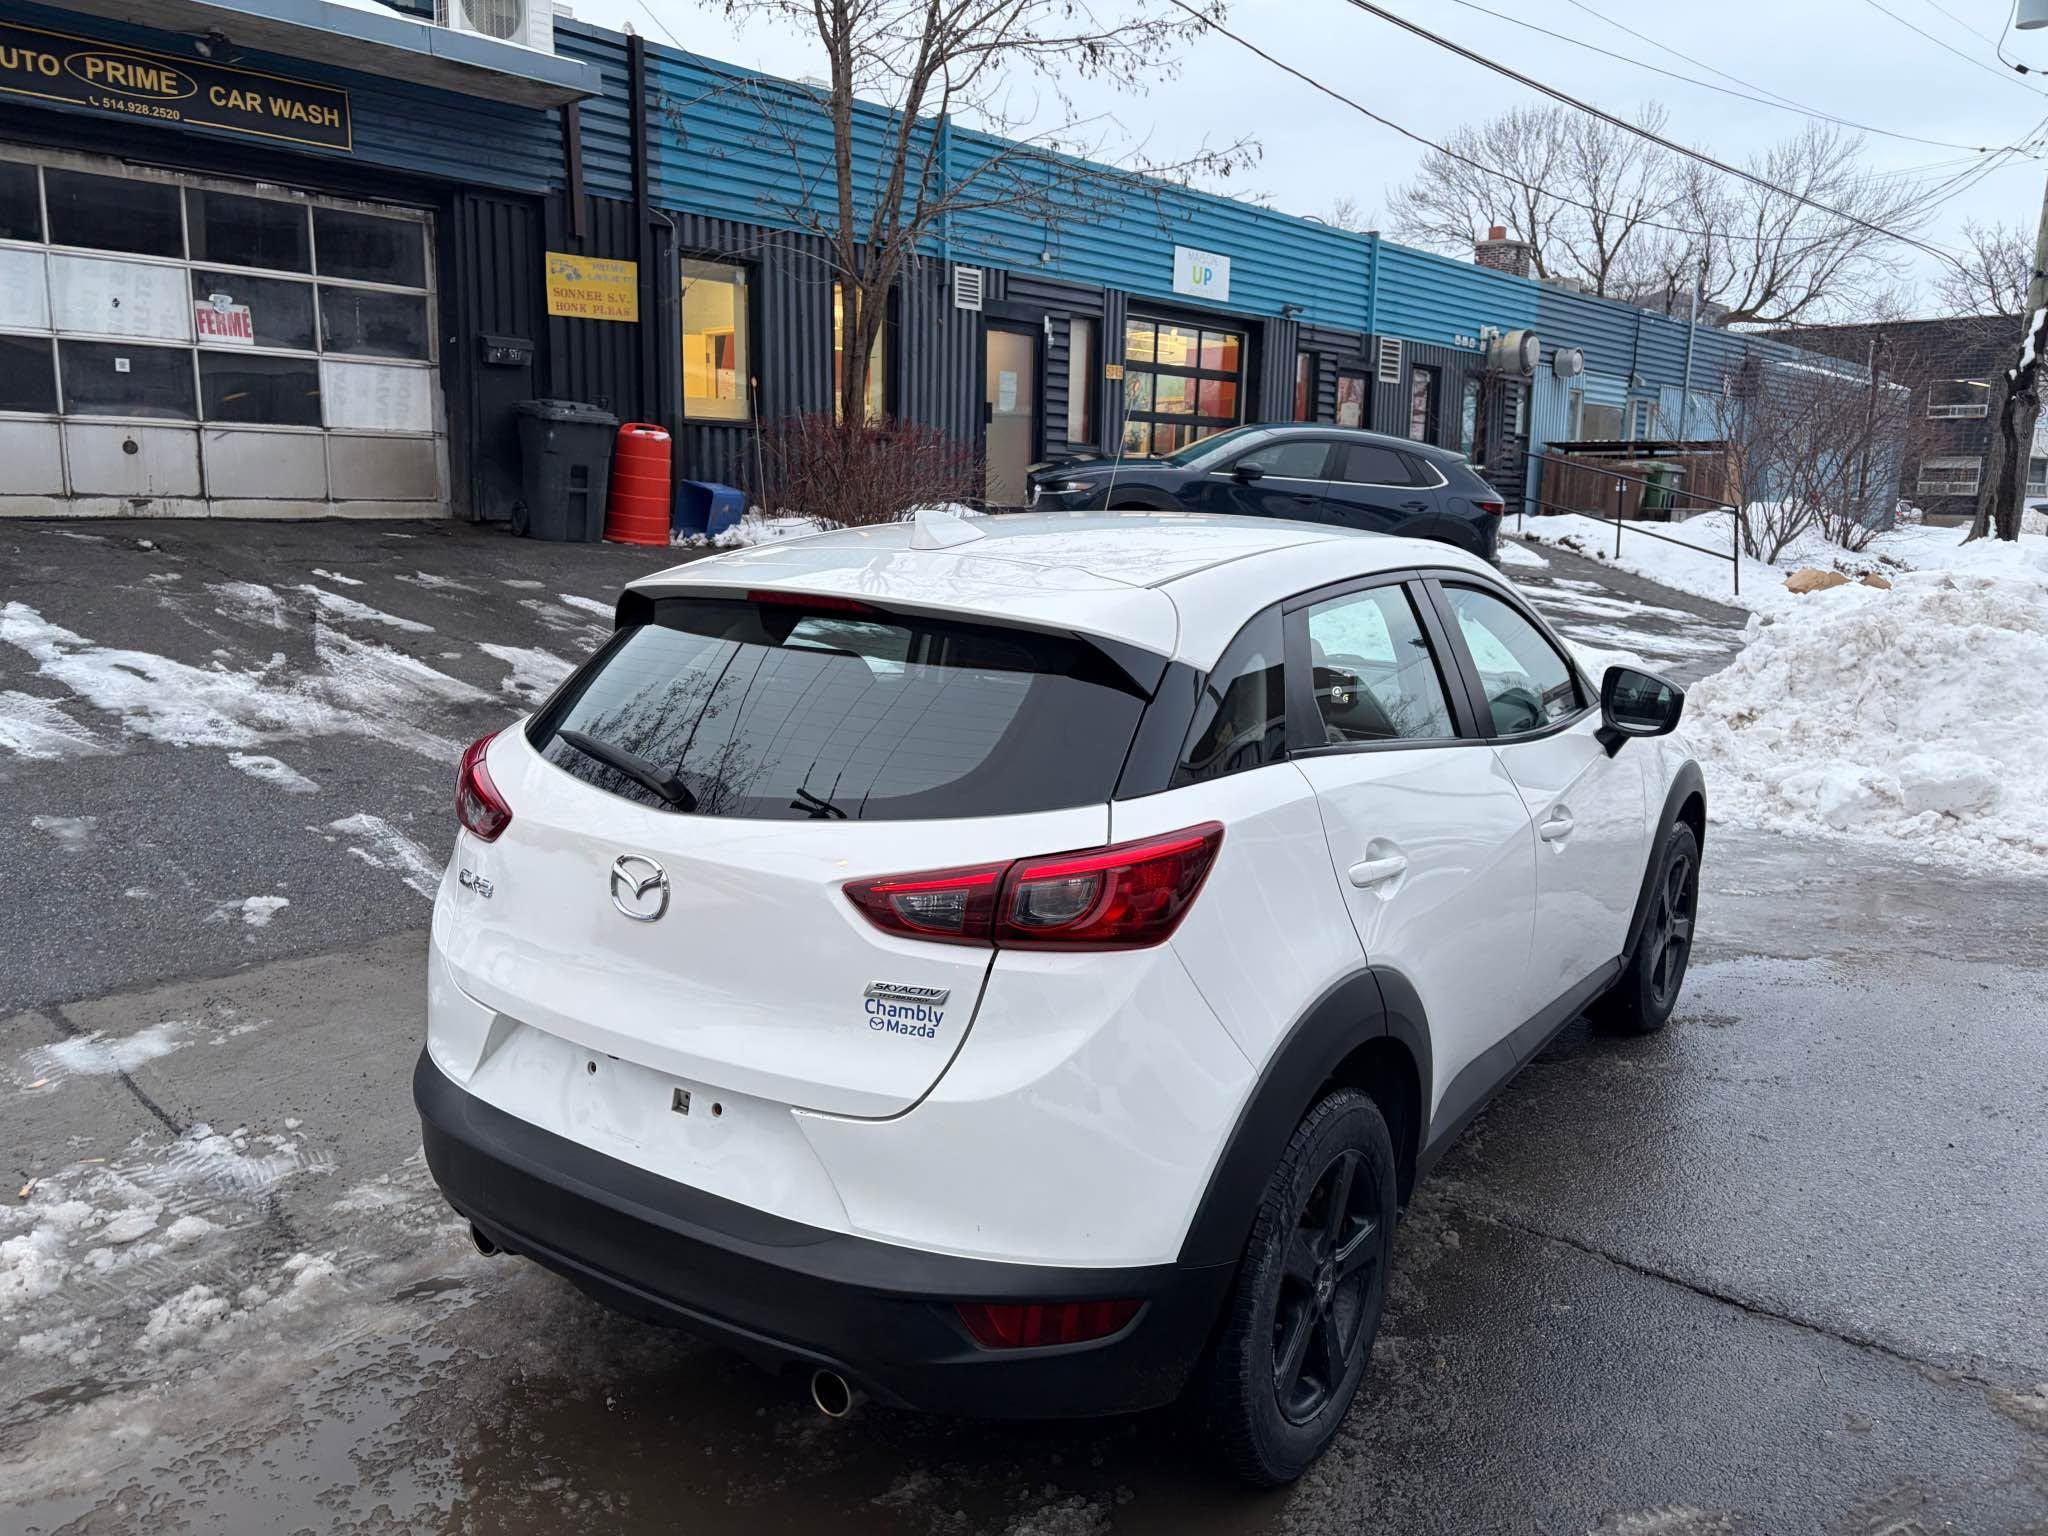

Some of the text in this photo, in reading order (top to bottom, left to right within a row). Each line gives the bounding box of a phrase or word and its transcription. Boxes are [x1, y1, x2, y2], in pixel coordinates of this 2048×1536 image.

[85, 56, 179, 95] PRIME
[209, 86, 264, 114] CAR
[268, 96, 340, 128] WASH
[103, 98, 181, 121] 514.928.2520
[1192, 264, 1214, 286] UP
[553, 287, 603, 302] SONNER
[555, 301, 587, 313] HONK
[196, 307, 253, 338] FERMÉ
[873, 982, 941, 997] SKYACTIV
[864, 998, 944, 1028] Chambly
[886, 1018, 936, 1039] Mazda
